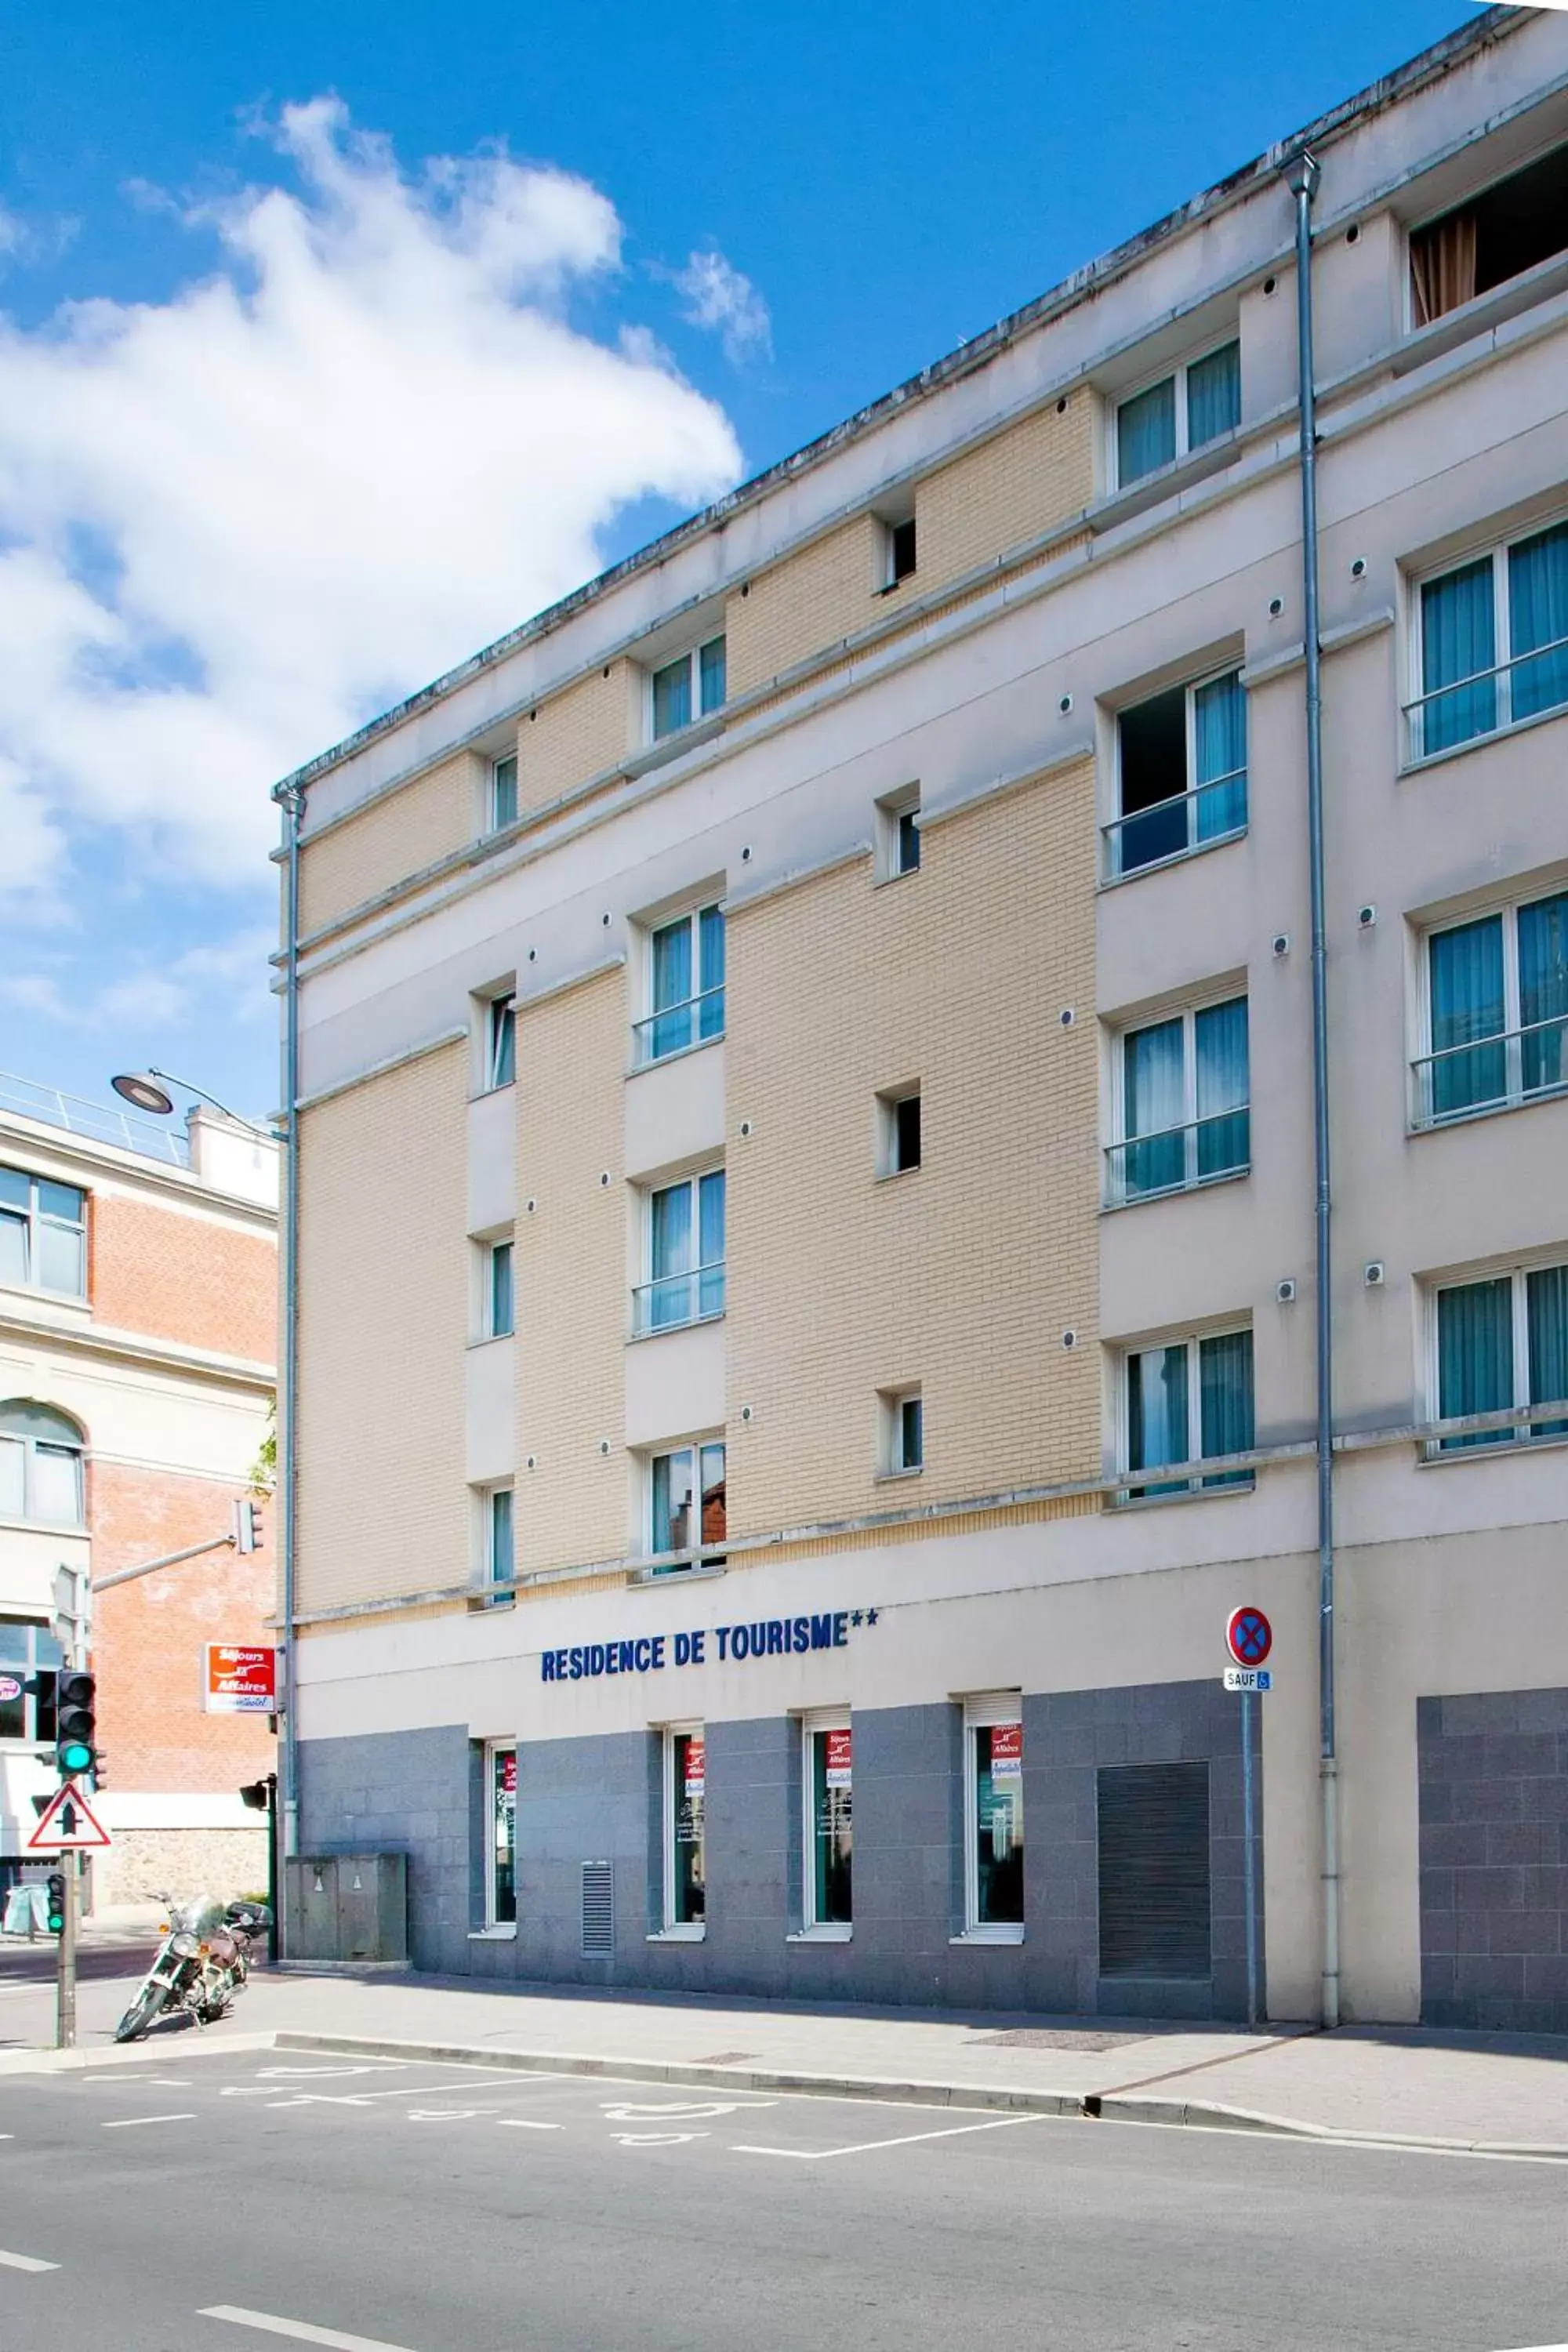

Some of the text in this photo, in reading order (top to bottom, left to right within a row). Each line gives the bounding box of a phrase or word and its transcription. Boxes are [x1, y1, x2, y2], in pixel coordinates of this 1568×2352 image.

[542, 1635, 665, 1682] RESIDENCE
[674, 1630, 705, 1666] DE
[216, 1679, 267, 1692] Affaires
[1228, 1673, 1255, 1686] SAUF
